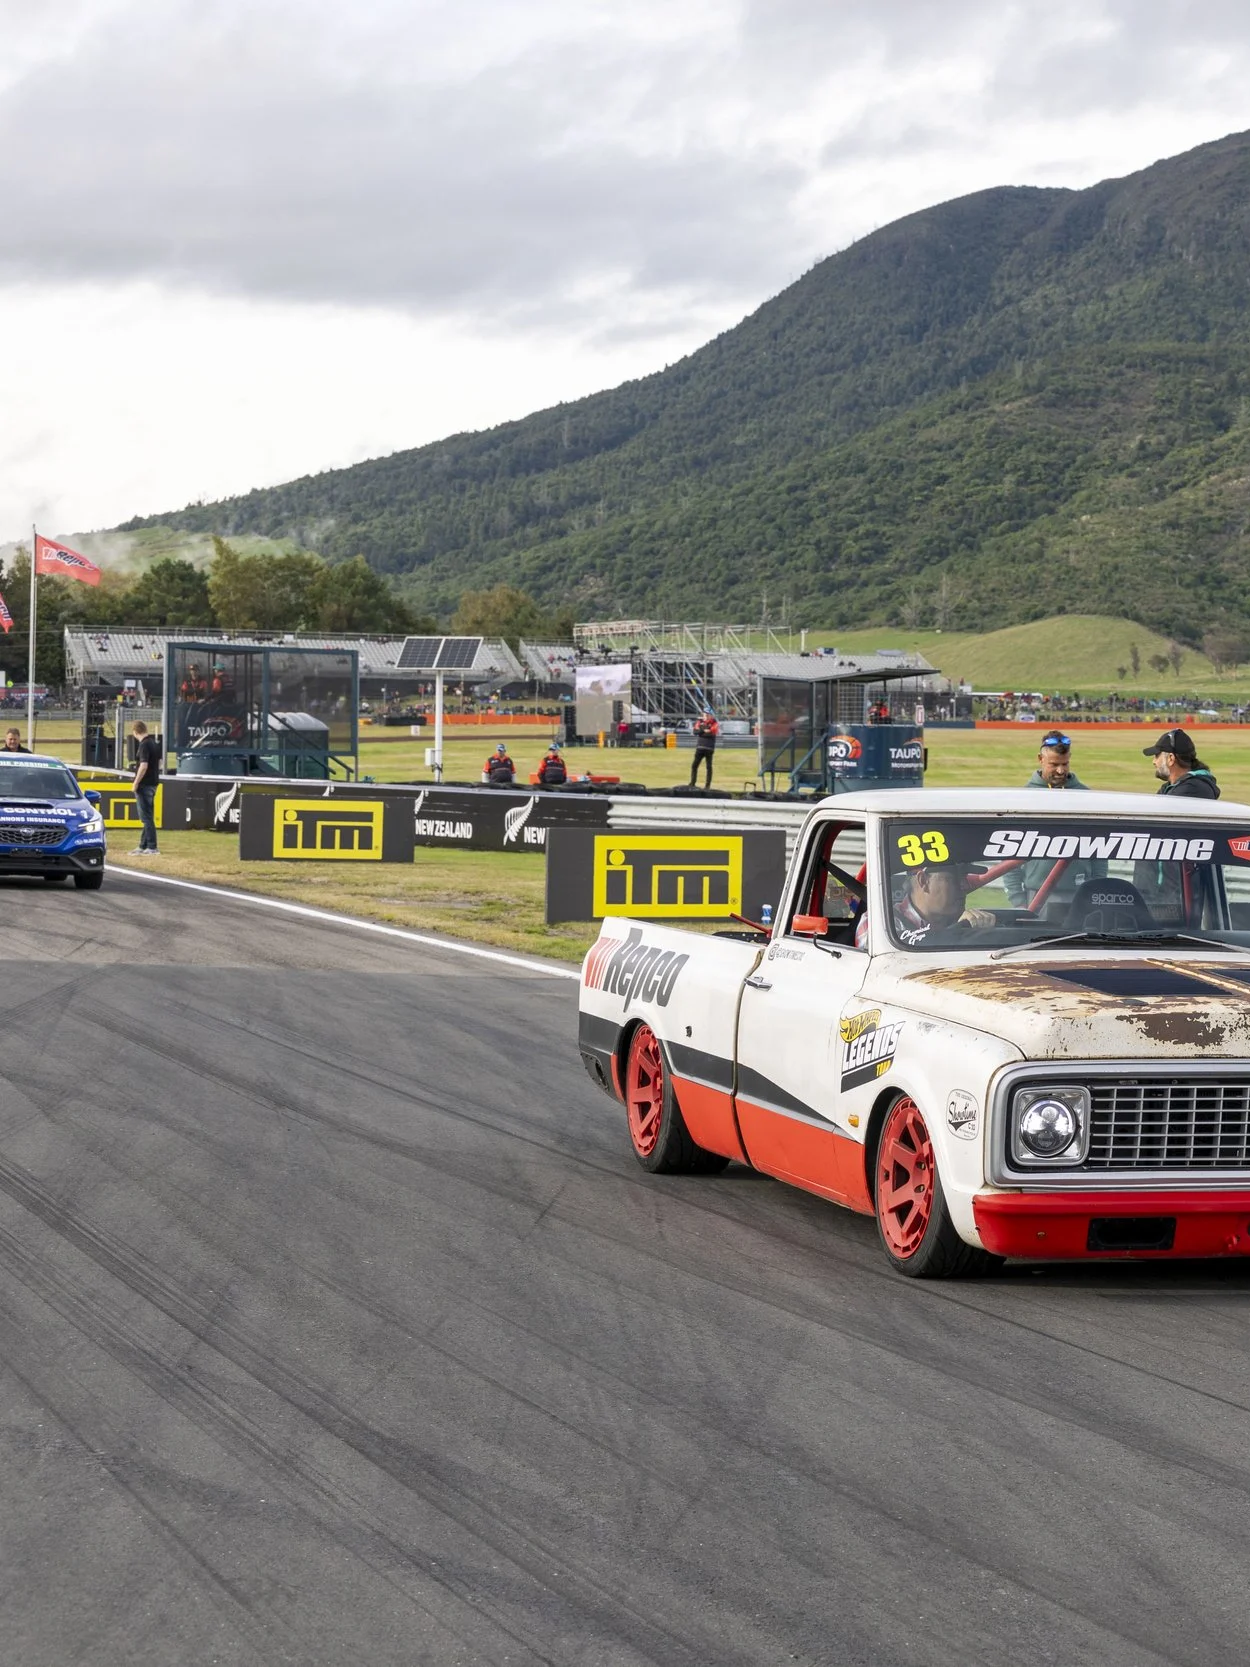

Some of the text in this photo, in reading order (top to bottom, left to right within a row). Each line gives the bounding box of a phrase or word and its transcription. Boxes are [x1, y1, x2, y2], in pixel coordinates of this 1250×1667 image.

[3, 807, 77, 816] CONTROL
[27, 816, 66, 824] INSURANCE
[229, 808, 240, 823] NE
[415, 819, 473, 839] NEW ZEALAND
[898, 831, 950, 867] 33
[983, 830, 1215, 861] ShowTime
[1091, 893, 1135, 906] sparco
[602, 927, 690, 1013] Repco
[842, 1021, 905, 1071] LEGENDS
